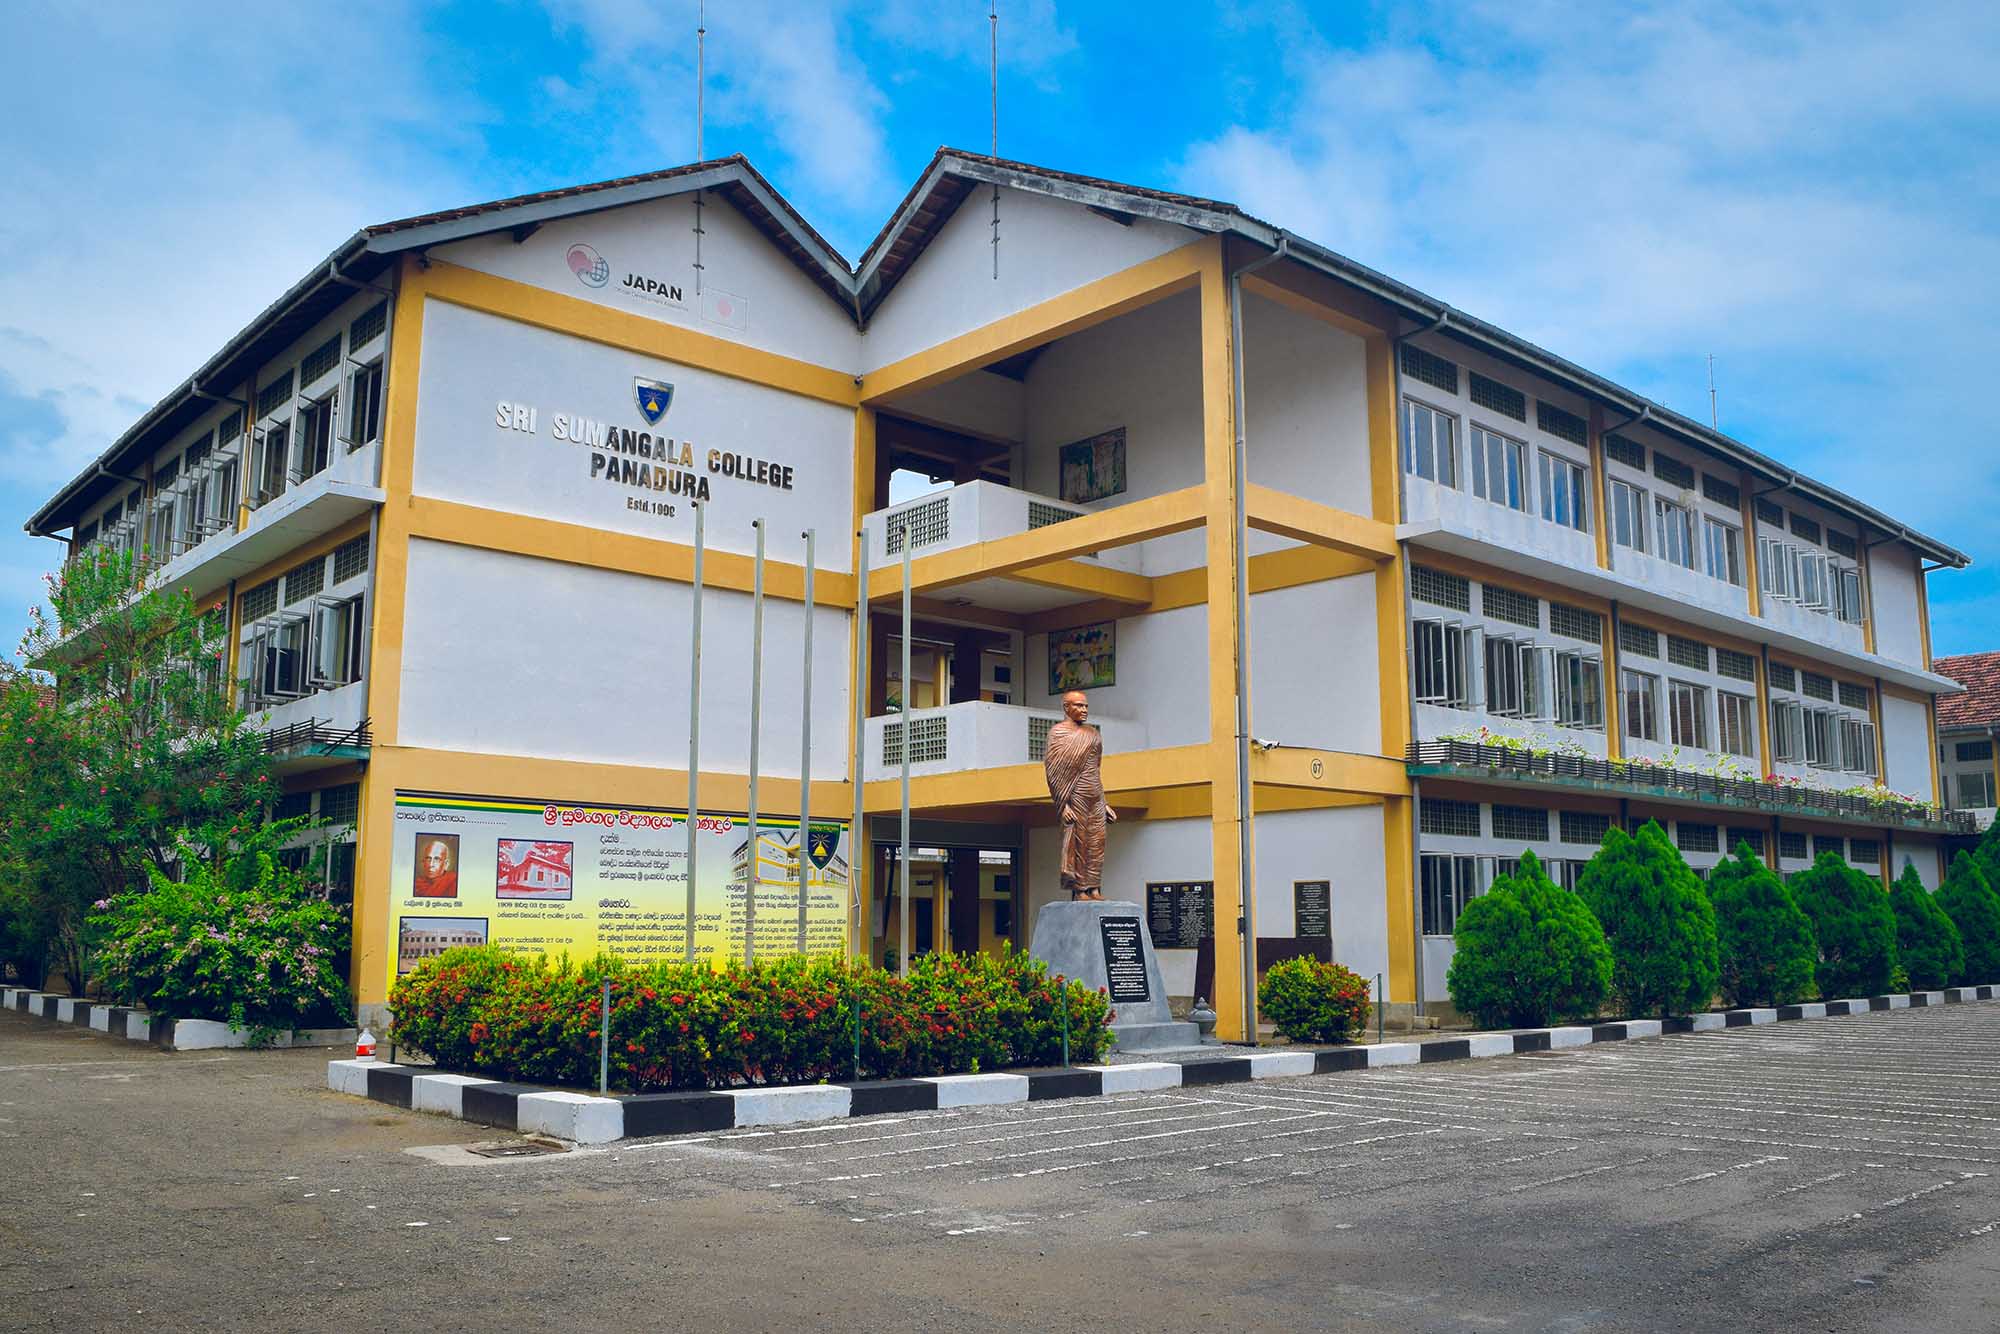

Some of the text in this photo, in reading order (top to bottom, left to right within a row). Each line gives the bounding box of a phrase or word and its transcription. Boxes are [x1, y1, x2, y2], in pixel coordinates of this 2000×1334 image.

[623, 273, 682, 301] JAPAN
[496, 401, 793, 491] SRI SUMANGALA COLLEGE
[591, 452, 710, 501] PANADURA
[562, 808, 615, 828] සුමංගල
[619, 811, 673, 830] විද්‍යාලය
